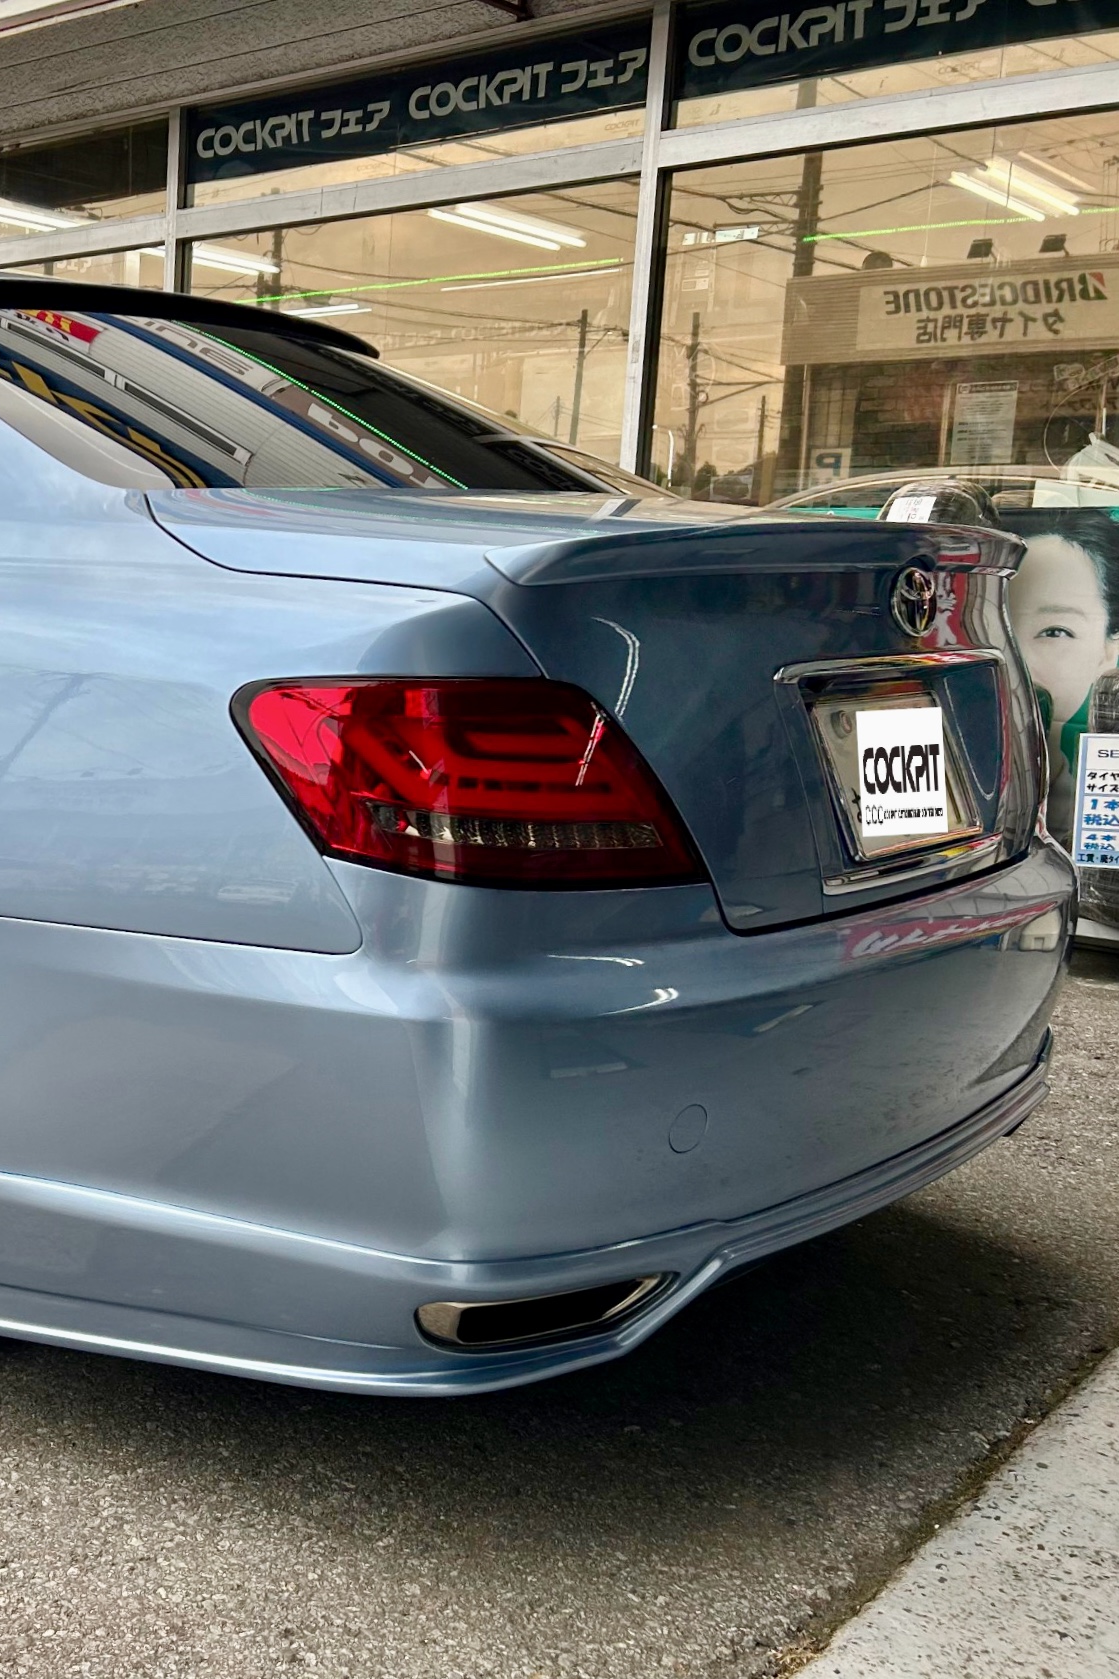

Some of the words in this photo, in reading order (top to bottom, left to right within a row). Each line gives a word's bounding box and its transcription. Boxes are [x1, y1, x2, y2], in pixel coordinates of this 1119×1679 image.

[688, 2, 871, 67] COCKPIT
[408, 62, 554, 120] COCKPIT
[561, 48, 647, 93] フェア
[196, 109, 316, 159] COCKPIT
[320, 100, 391, 138] フェア
